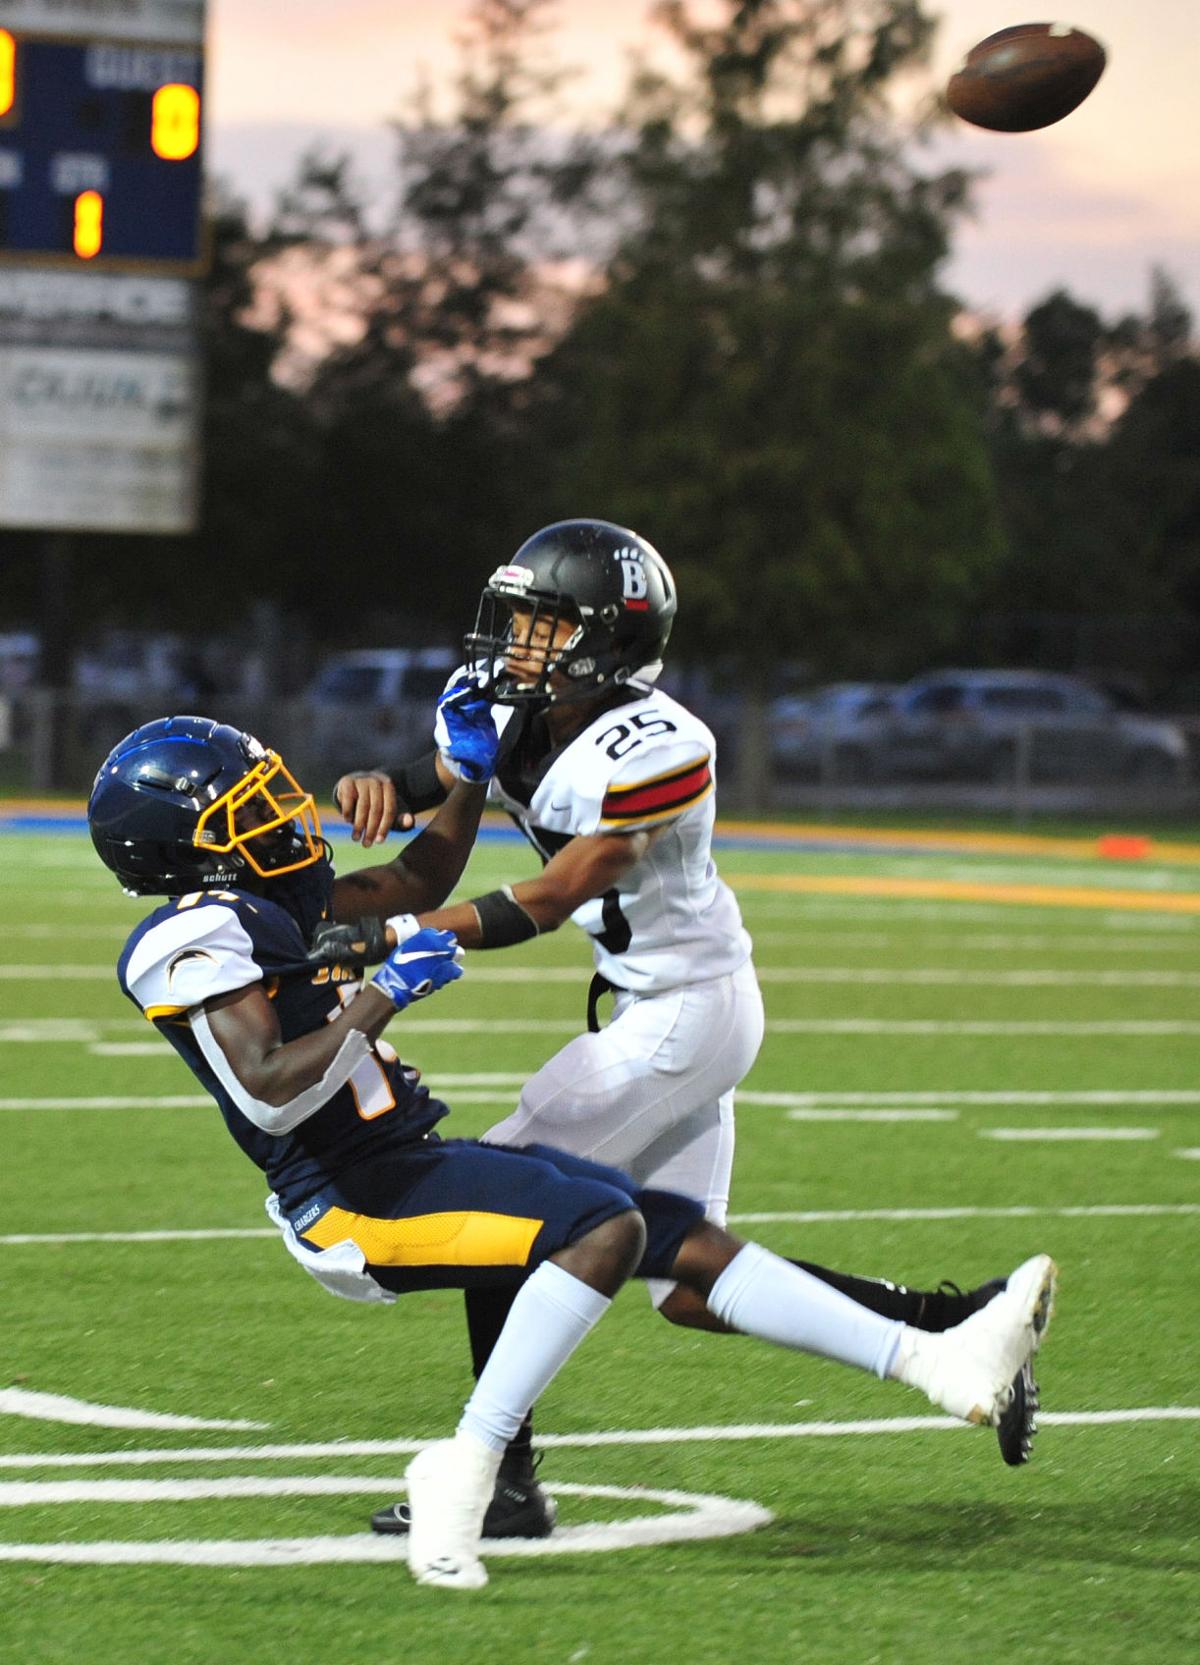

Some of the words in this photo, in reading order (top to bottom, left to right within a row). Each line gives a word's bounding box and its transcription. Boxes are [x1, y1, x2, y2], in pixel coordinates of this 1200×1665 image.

[620, 560, 648, 600] B
[595, 709, 677, 761] 25
[294, 1203, 320, 1232] CHARGERS
